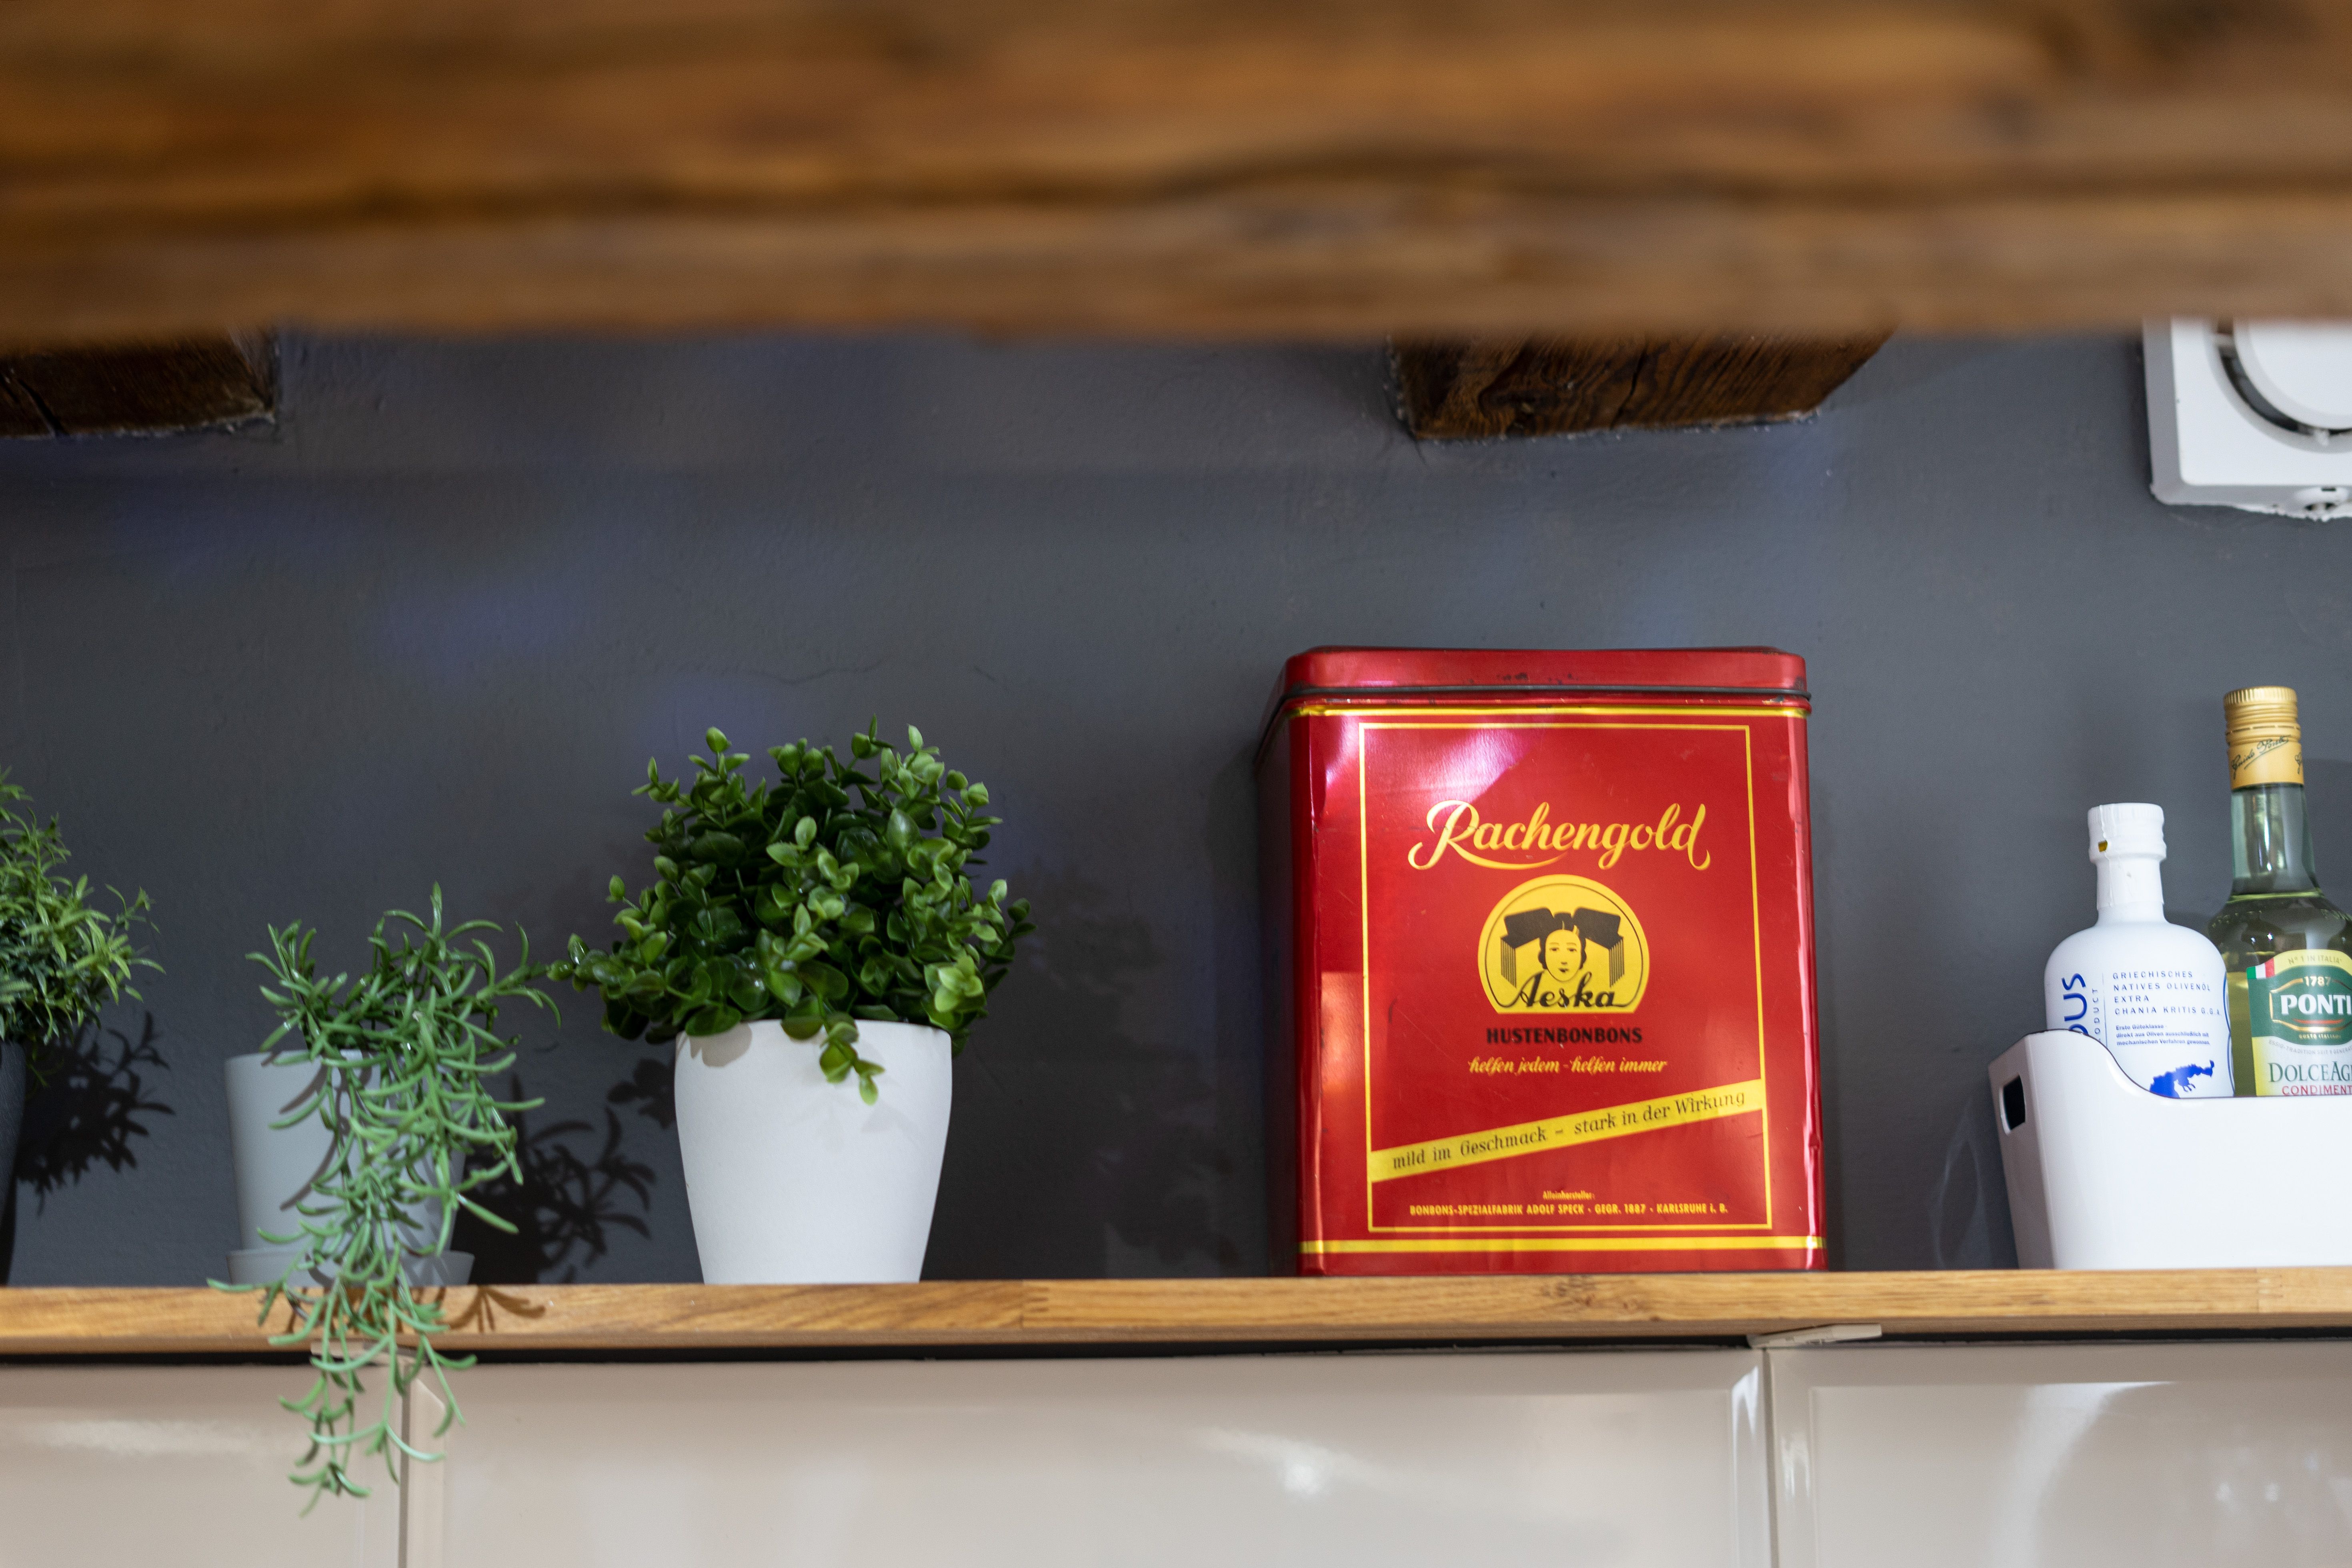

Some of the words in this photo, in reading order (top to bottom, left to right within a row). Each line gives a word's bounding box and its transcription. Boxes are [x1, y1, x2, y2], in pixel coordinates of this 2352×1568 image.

[1407, 799, 1710, 870] Rachengold
[2113, 971, 2193, 979] GRIECHISCHES
[2304, 976, 2331, 987] 1787
[1512, 971, 1620, 1008] Aeska
[2114, 983, 2160, 991] NATIVES
[2167, 982, 2210, 991] OLIVENÖL
[2092, 988, 2101, 1041] ODUCT
[2115, 1007, 2157, 1015] CHANIA
[2280, 994, 2352, 1015] PONTI
[1486, 1027, 1643, 1044] HUSTENBONBONS
[1468, 1056, 1514, 1076] helfen
[1514, 1056, 1559, 1076] jedem
[1570, 1055, 1615, 1075] helfen
[1619, 1057, 1668, 1073] immer
[2268, 1061, 2352, 1082] DOLCEAG
[1392, 1149, 1425, 1170] mild
[1433, 1147, 1451, 1161] im
[1460, 1125, 1547, 1156] Geschmack
[1574, 1114, 1616, 1135] stark
[1621, 1111, 1637, 1126] in
[1643, 1104, 1671, 1121] der
[1675, 1091, 1745, 1114] Wirkung
[1409, 1204, 1523, 1216] BONBONS-SPEZIALFABRIK
[1526, 1204, 1555, 1215] ADOLF
[1558, 1204, 1584, 1215] SPECK
[1594, 1204, 1621, 1214] GEGR.
[1624, 1204, 1646, 1214] 1887
[1656, 1203, 1707, 1214] KARLSRUHE
